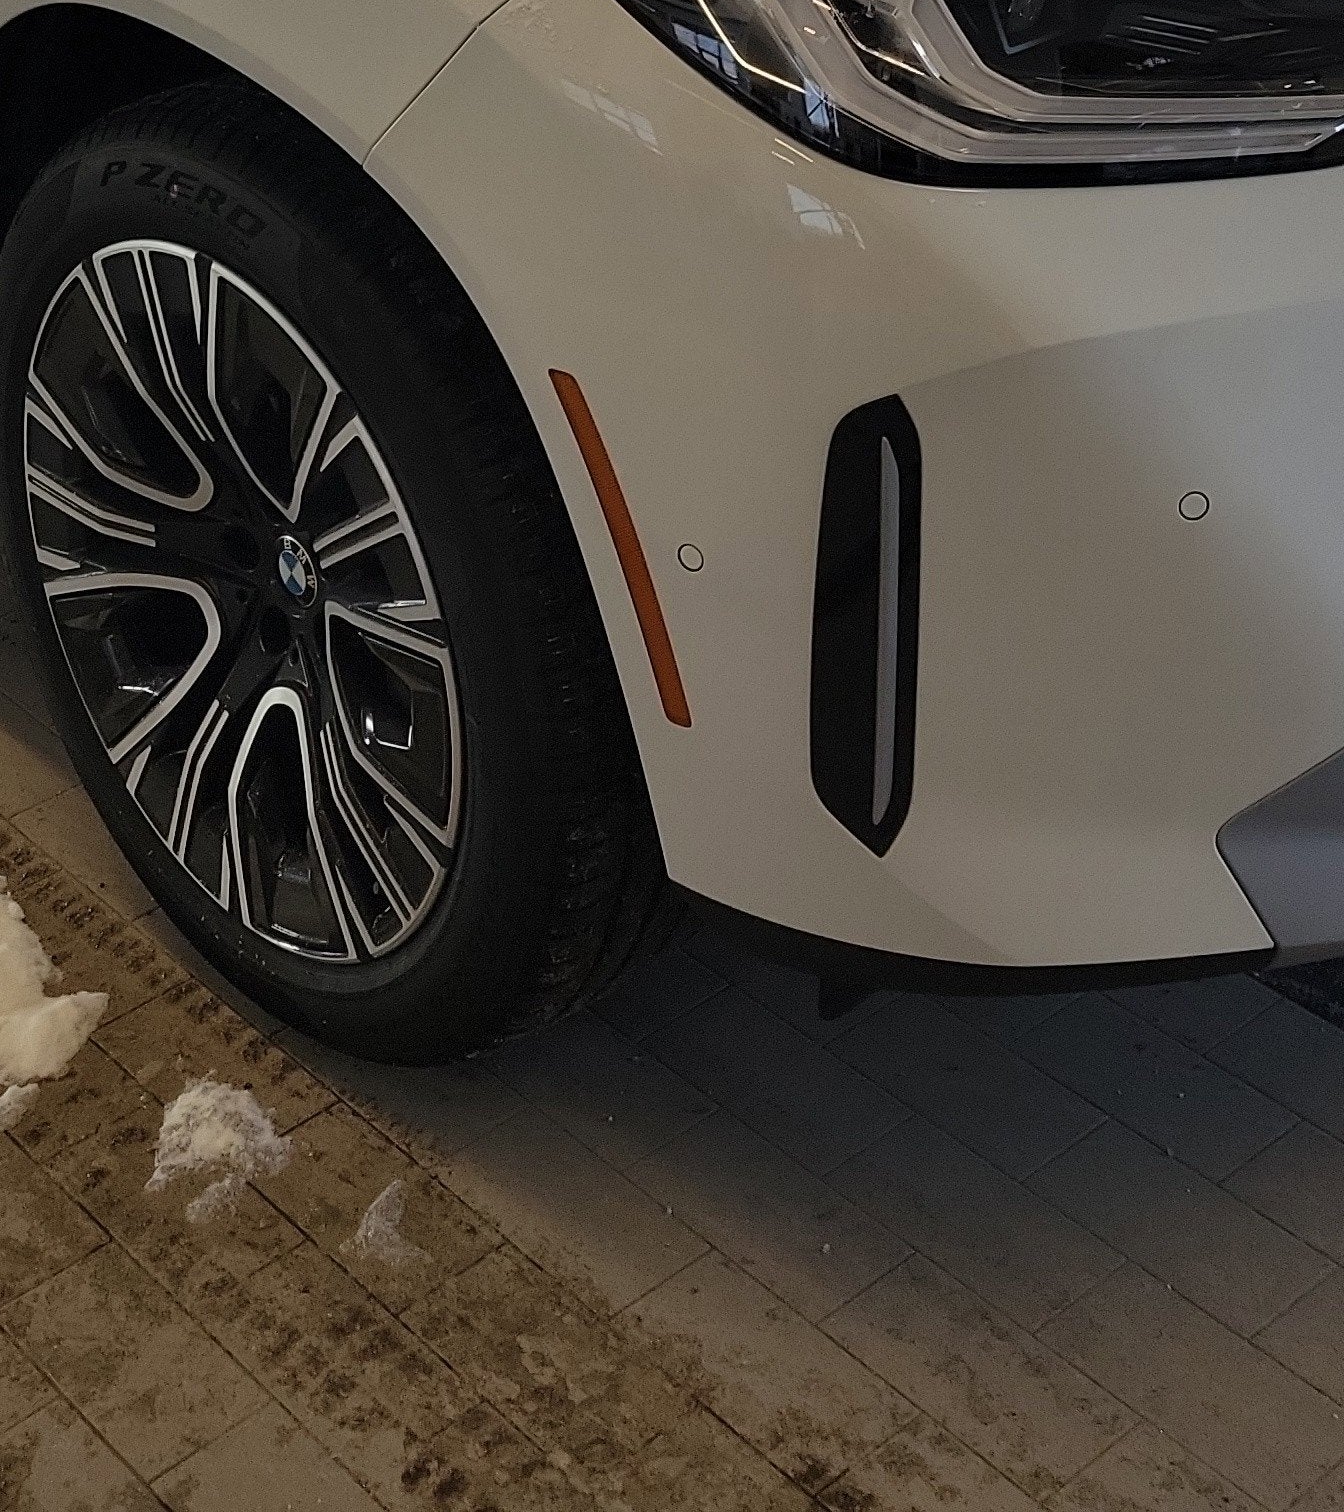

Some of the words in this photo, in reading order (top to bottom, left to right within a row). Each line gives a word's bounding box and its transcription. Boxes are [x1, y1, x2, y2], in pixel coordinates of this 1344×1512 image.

[100, 160, 127, 186] P
[134, 162, 269, 238] ZERO
[283, 537, 317, 589] BMW
